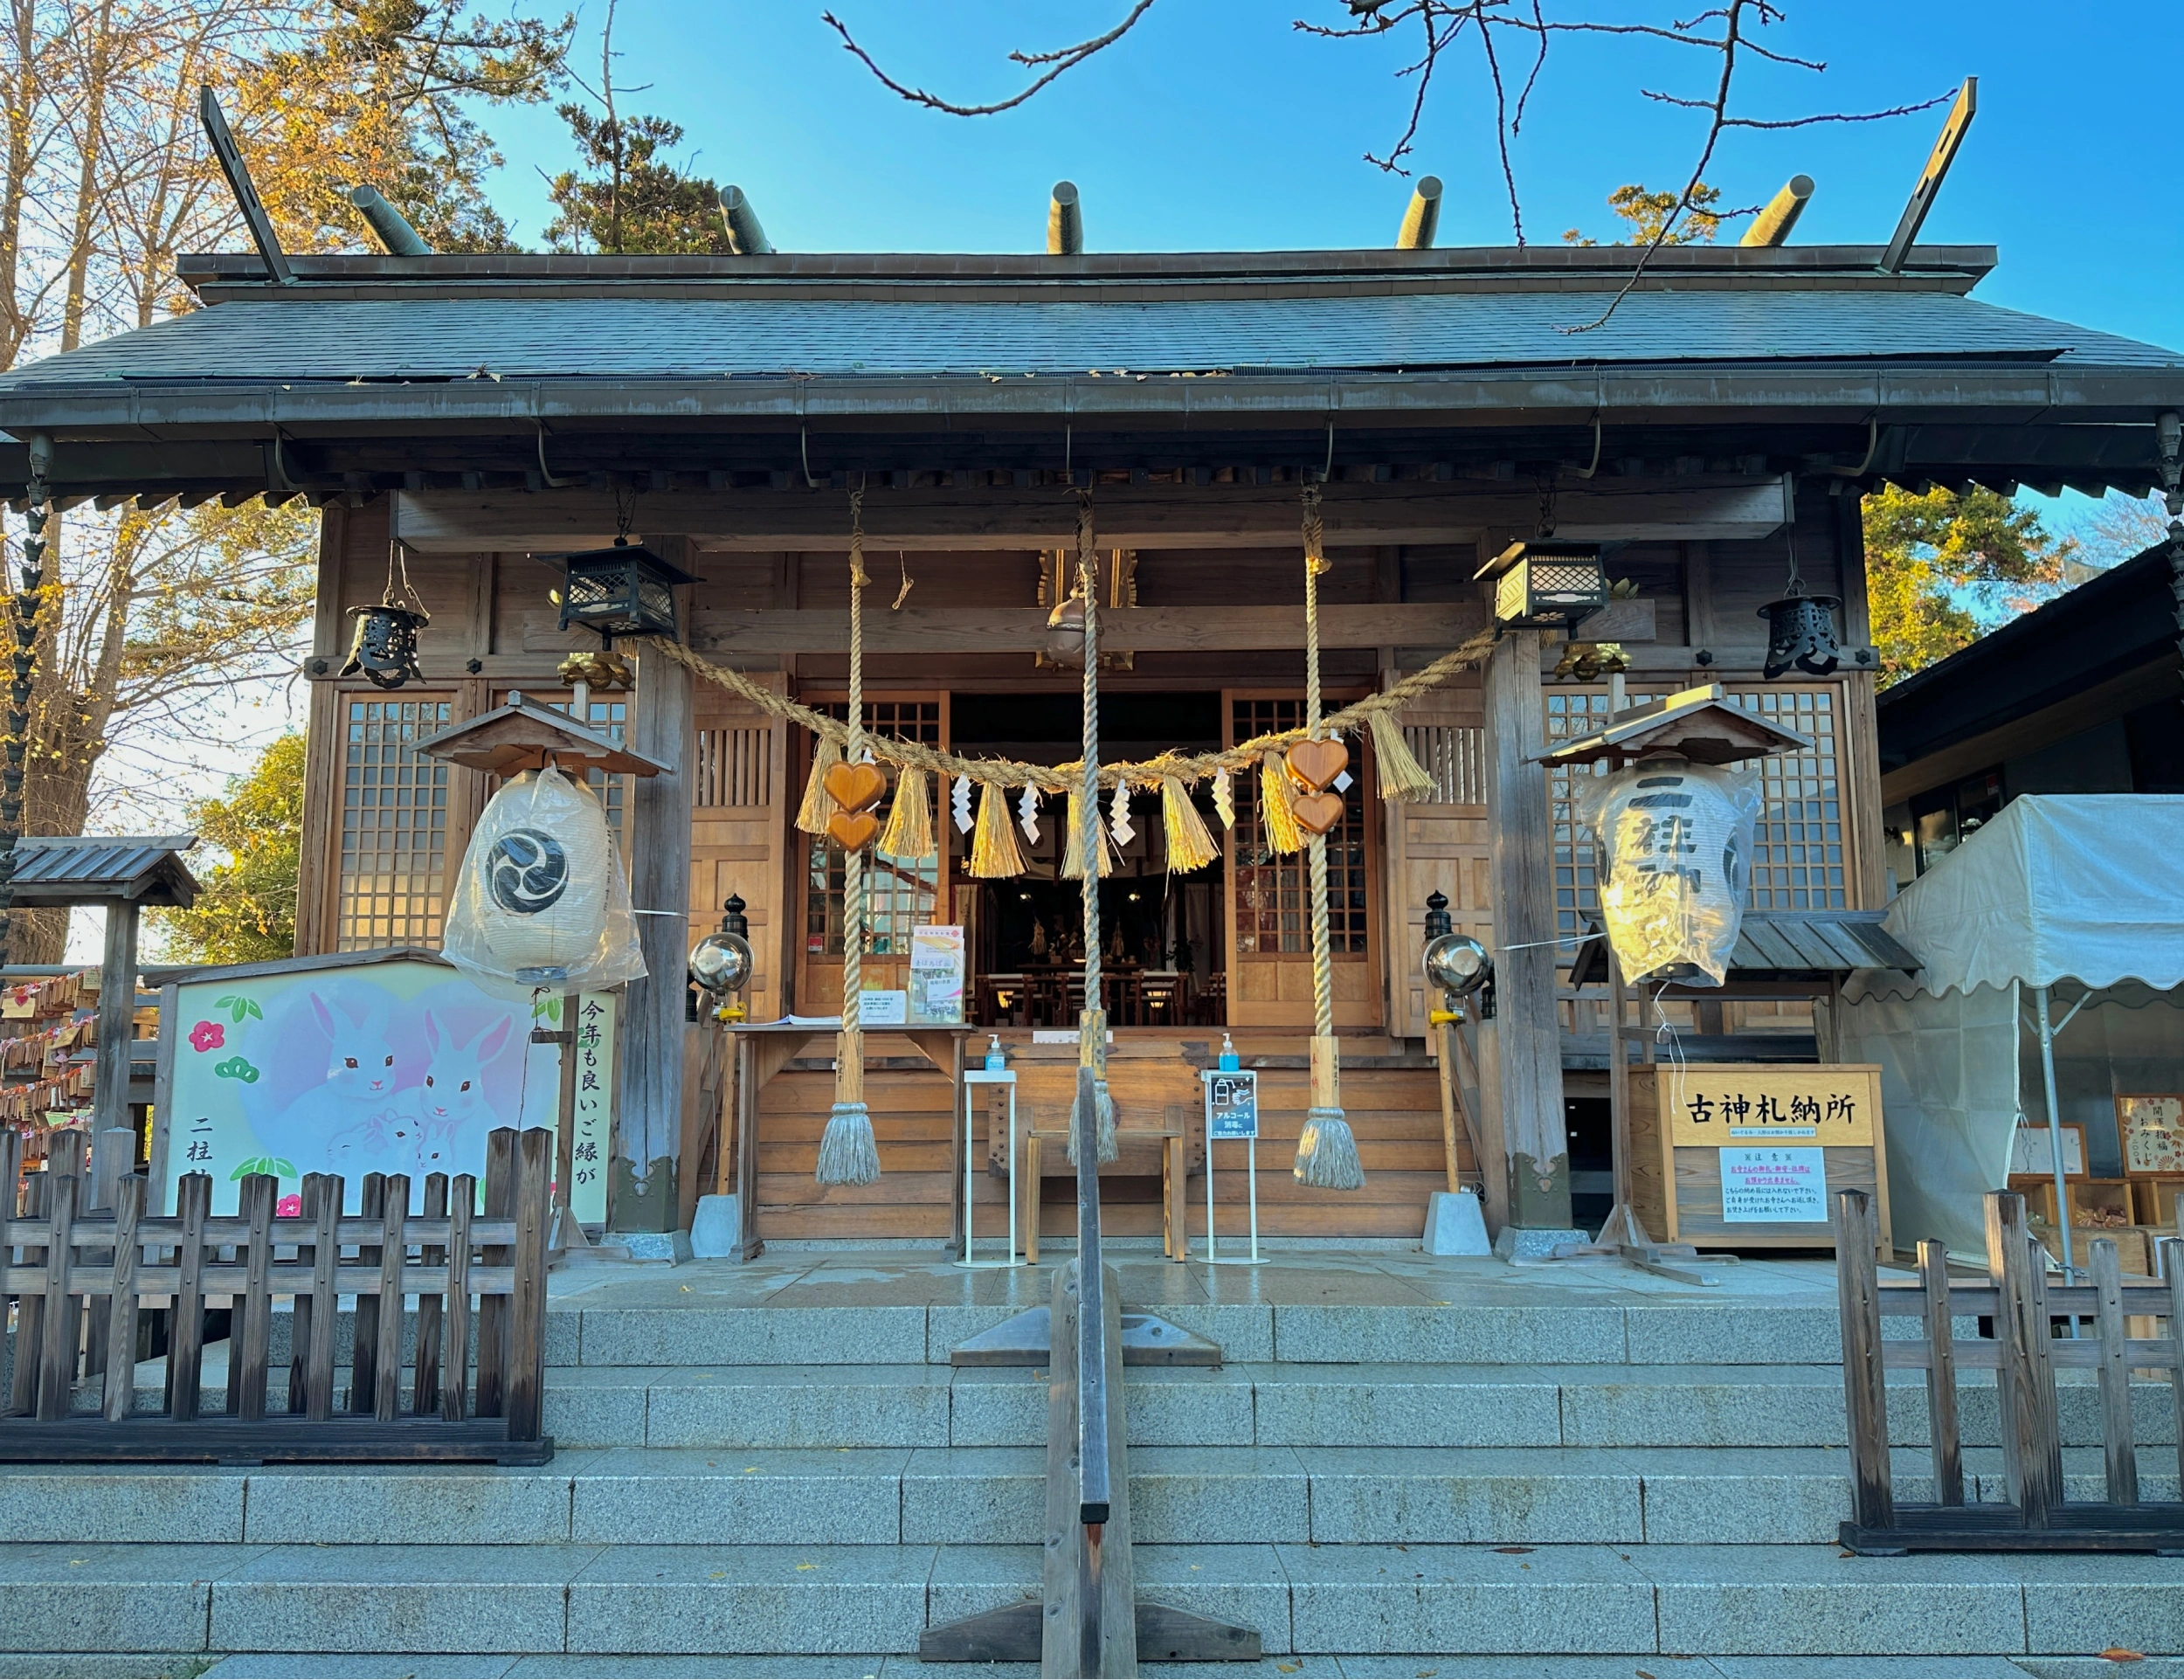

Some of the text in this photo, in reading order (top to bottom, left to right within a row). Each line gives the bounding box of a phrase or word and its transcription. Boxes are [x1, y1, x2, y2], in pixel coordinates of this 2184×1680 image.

[575, 999, 605, 1185] 今年も良いご縁が
[1686, 1093, 1856, 1124] 古神札納所
[187, 1117, 213, 1176] 二柱
[2140, 1117, 2153, 1162] おみくじ
[2153, 1105, 2168, 1151] 開運招福
